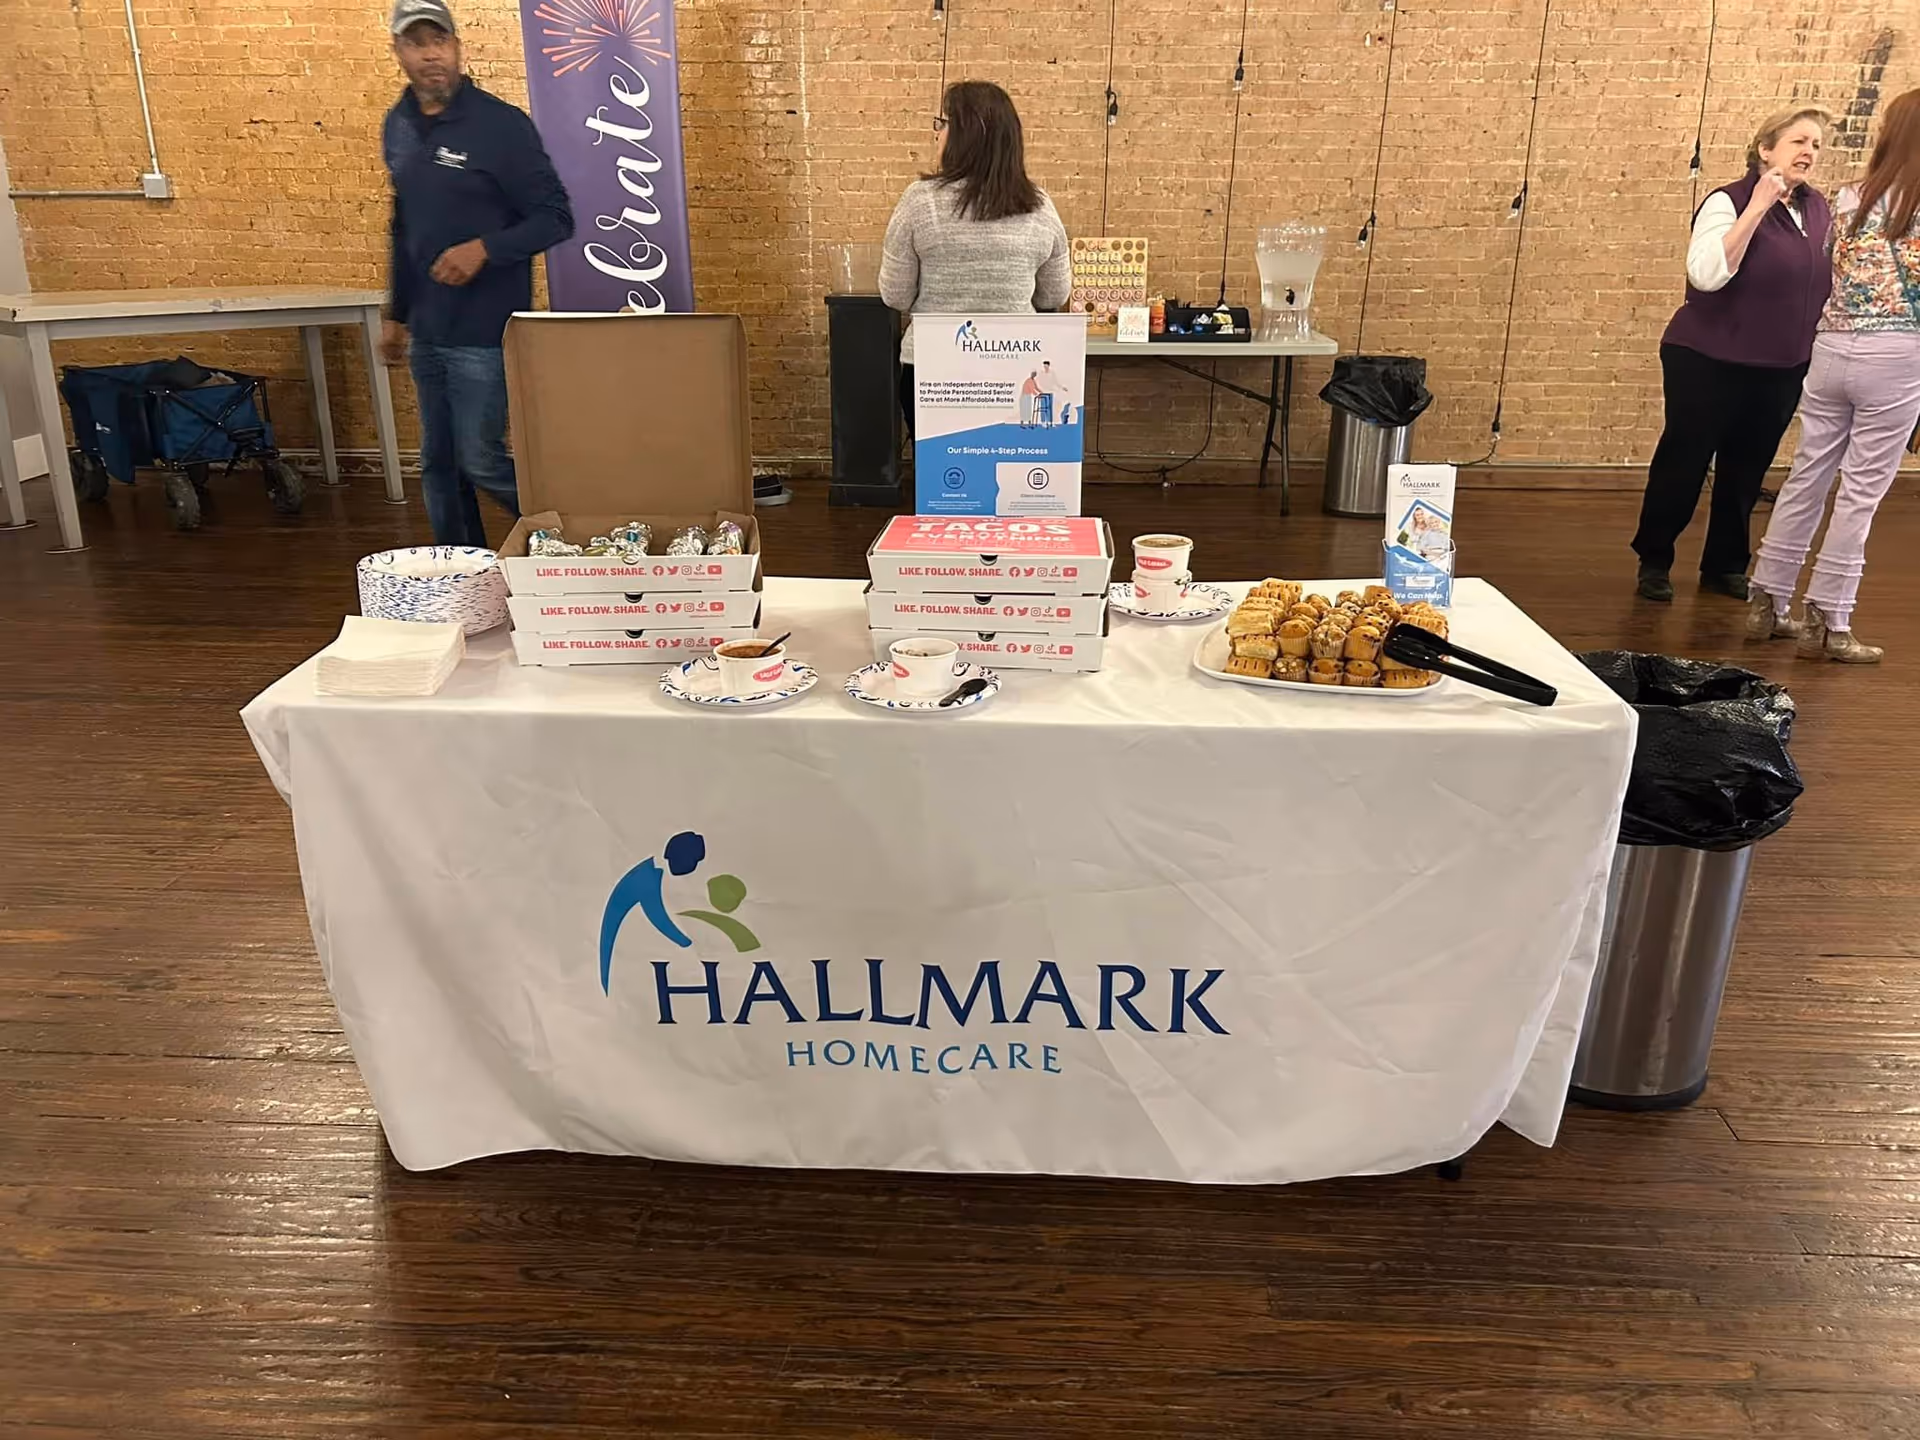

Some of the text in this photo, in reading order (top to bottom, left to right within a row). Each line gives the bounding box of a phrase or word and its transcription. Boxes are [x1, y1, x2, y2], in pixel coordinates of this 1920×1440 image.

[584, 56, 667, 313] ebrate
[962, 340, 1041, 352] HALLMARK
[943, 381, 983, 389] Independent
[984, 381, 1015, 389] Caregiver
[947, 446, 1049, 456] Our Simple 4-Step Process
[912, 522, 1073, 535] TACOS
[536, 567, 647, 577] LIKE. FOLLOW. SHARE.
[899, 567, 1004, 577] LIKE. FOLLOW. SHARE.
[1393, 591, 1406, 599] We
[1407, 591, 1423, 599] Can
[540, 605, 650, 616] LIKE. FOLLOW. SHARE.
[894, 604, 998, 615] LIKE. FOLLOW. SHARE.
[543, 640, 650, 649] LIKE. FOLLOW. SHARE.
[967, 643, 1001, 652] SHARE.
[648, 957, 1231, 1036] HALLMARK
[785, 1039, 1063, 1074] HOMECARE
